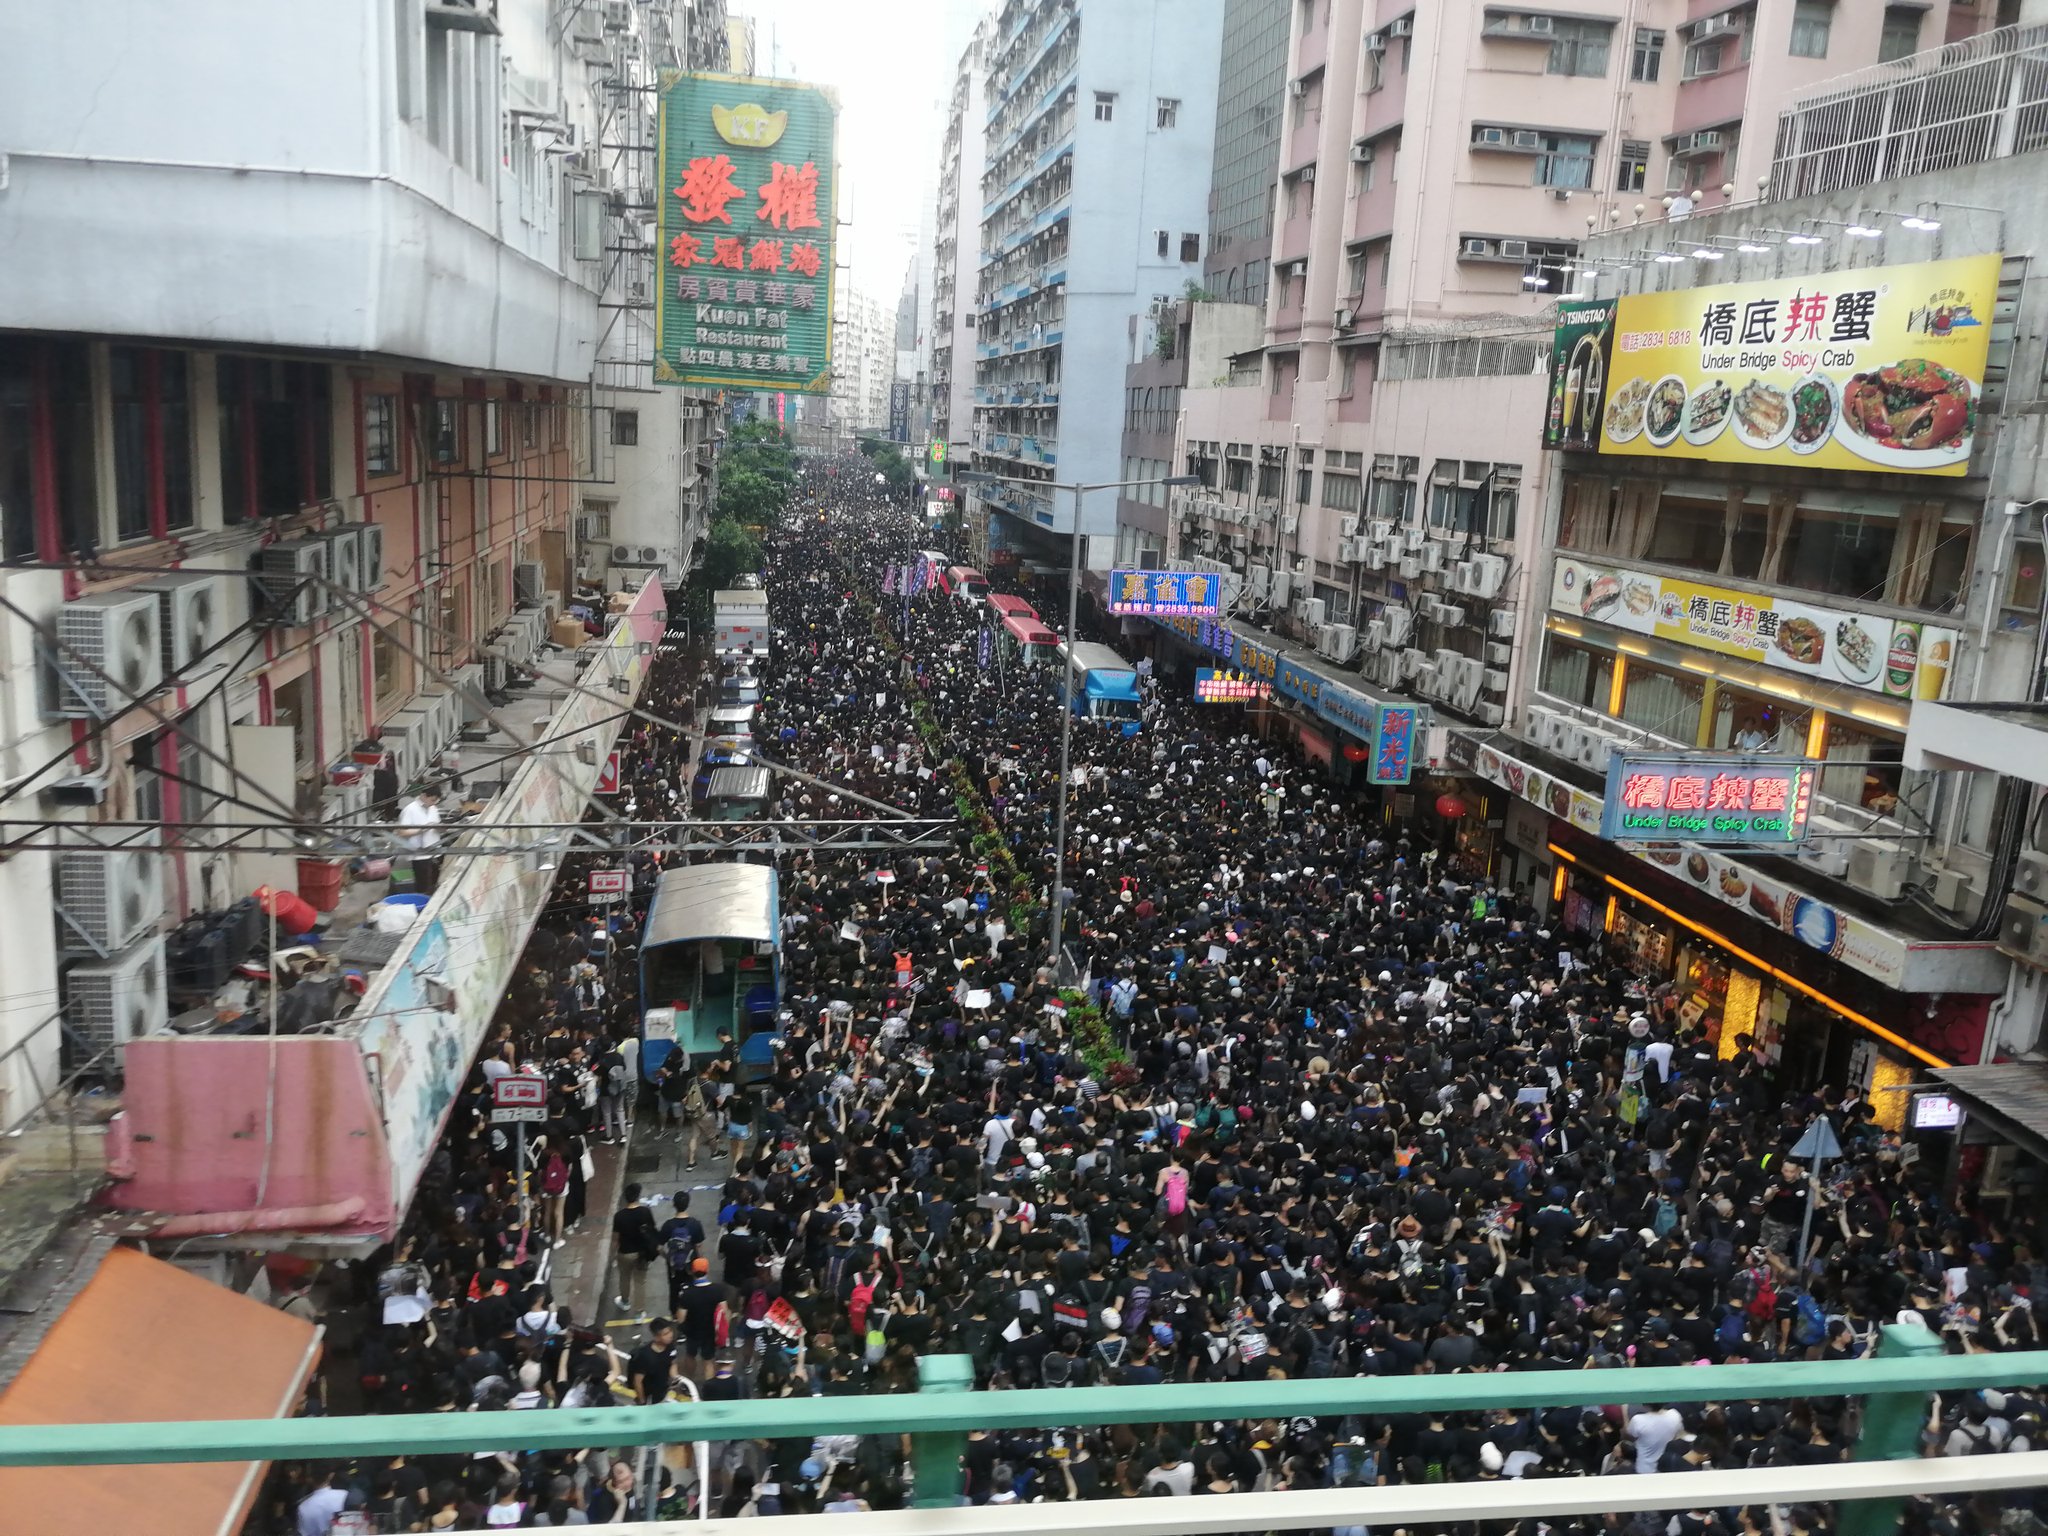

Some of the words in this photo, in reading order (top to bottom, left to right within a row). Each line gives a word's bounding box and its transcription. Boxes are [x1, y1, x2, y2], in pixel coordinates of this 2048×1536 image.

[731, 116, 769, 141] KF
[695, 302, 750, 326] Kuen
[754, 306, 788, 329] Fat
[1566, 308, 1606, 325] TSINGTAO
[1698, 286, 1876, 347] 橋底辣蟹
[695, 326, 788, 349] Restaurant
[1668, 330, 1691, 346] 6818
[1702, 353, 1735, 369] Under
[1739, 352, 1776, 371] Bridge
[1782, 349, 1817, 373] Spicy
[1822, 349, 1855, 367] Crab
[1122, 573, 1210, 603] 嘉雀會
[1689, 594, 1779, 638] 橋底辣蟹
[1690, 622, 1708, 635] Under
[1710, 627, 1730, 641] Bridge
[1732, 631, 1752, 648] Spicy
[1752, 637, 1770, 650] Crab
[1624, 773, 1789, 812] 橋底辣蟹
[1624, 814, 1663, 829] Under
[1667, 814, 1709, 830] Bridge
[1713, 815, 1750, 833] Spicy
[1753, 816, 1785, 832] Crab
